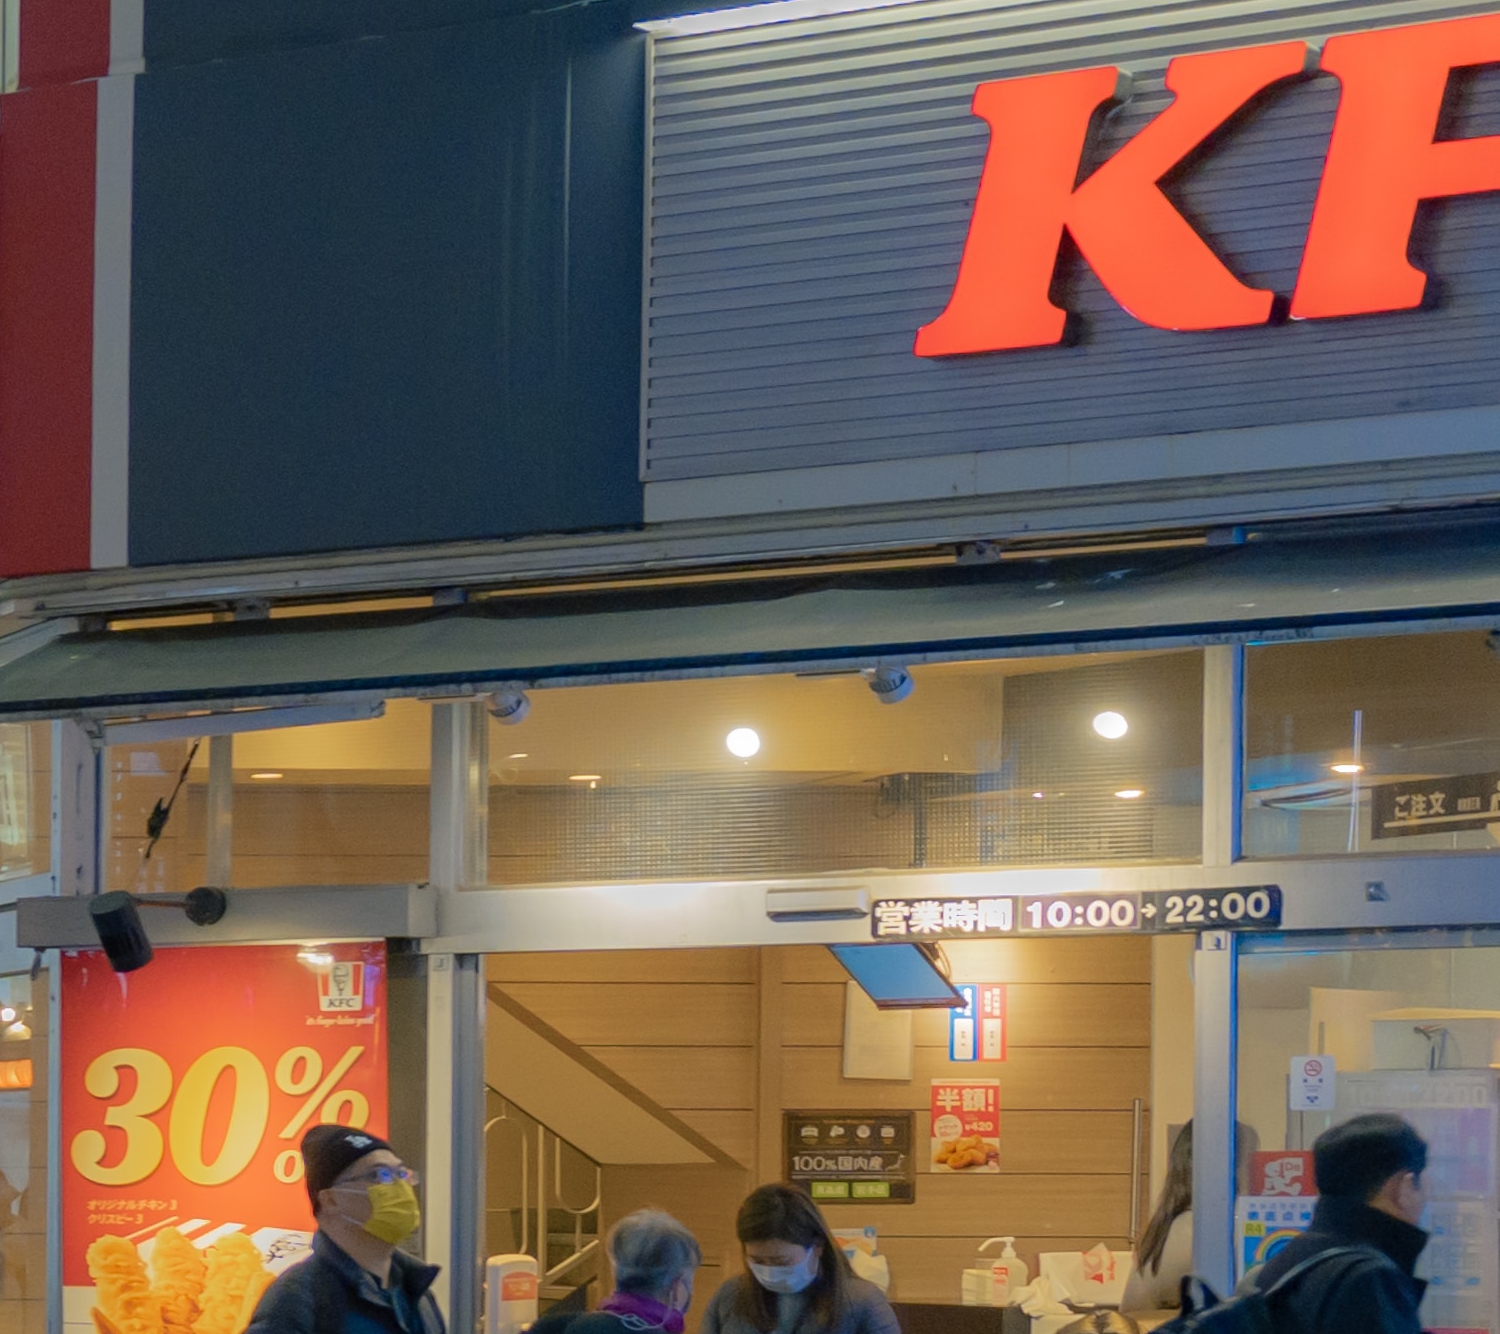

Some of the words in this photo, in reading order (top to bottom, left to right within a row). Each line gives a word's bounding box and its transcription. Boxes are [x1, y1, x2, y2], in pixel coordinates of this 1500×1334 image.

[914, 14, 1500, 358] KF
[875, 898, 1012, 935] 営業時間
[1026, 898, 1136, 930] 10:00
[1164, 890, 1271, 922] 22:00
[327, 998, 355, 1008] KFC
[936, 1088, 995, 1113] 半額!
[70, 1045, 370, 1187] 30%
[86, 1199, 167, 1211] オリジナルチキン
[87, 1213, 134, 1224] クリスピー
